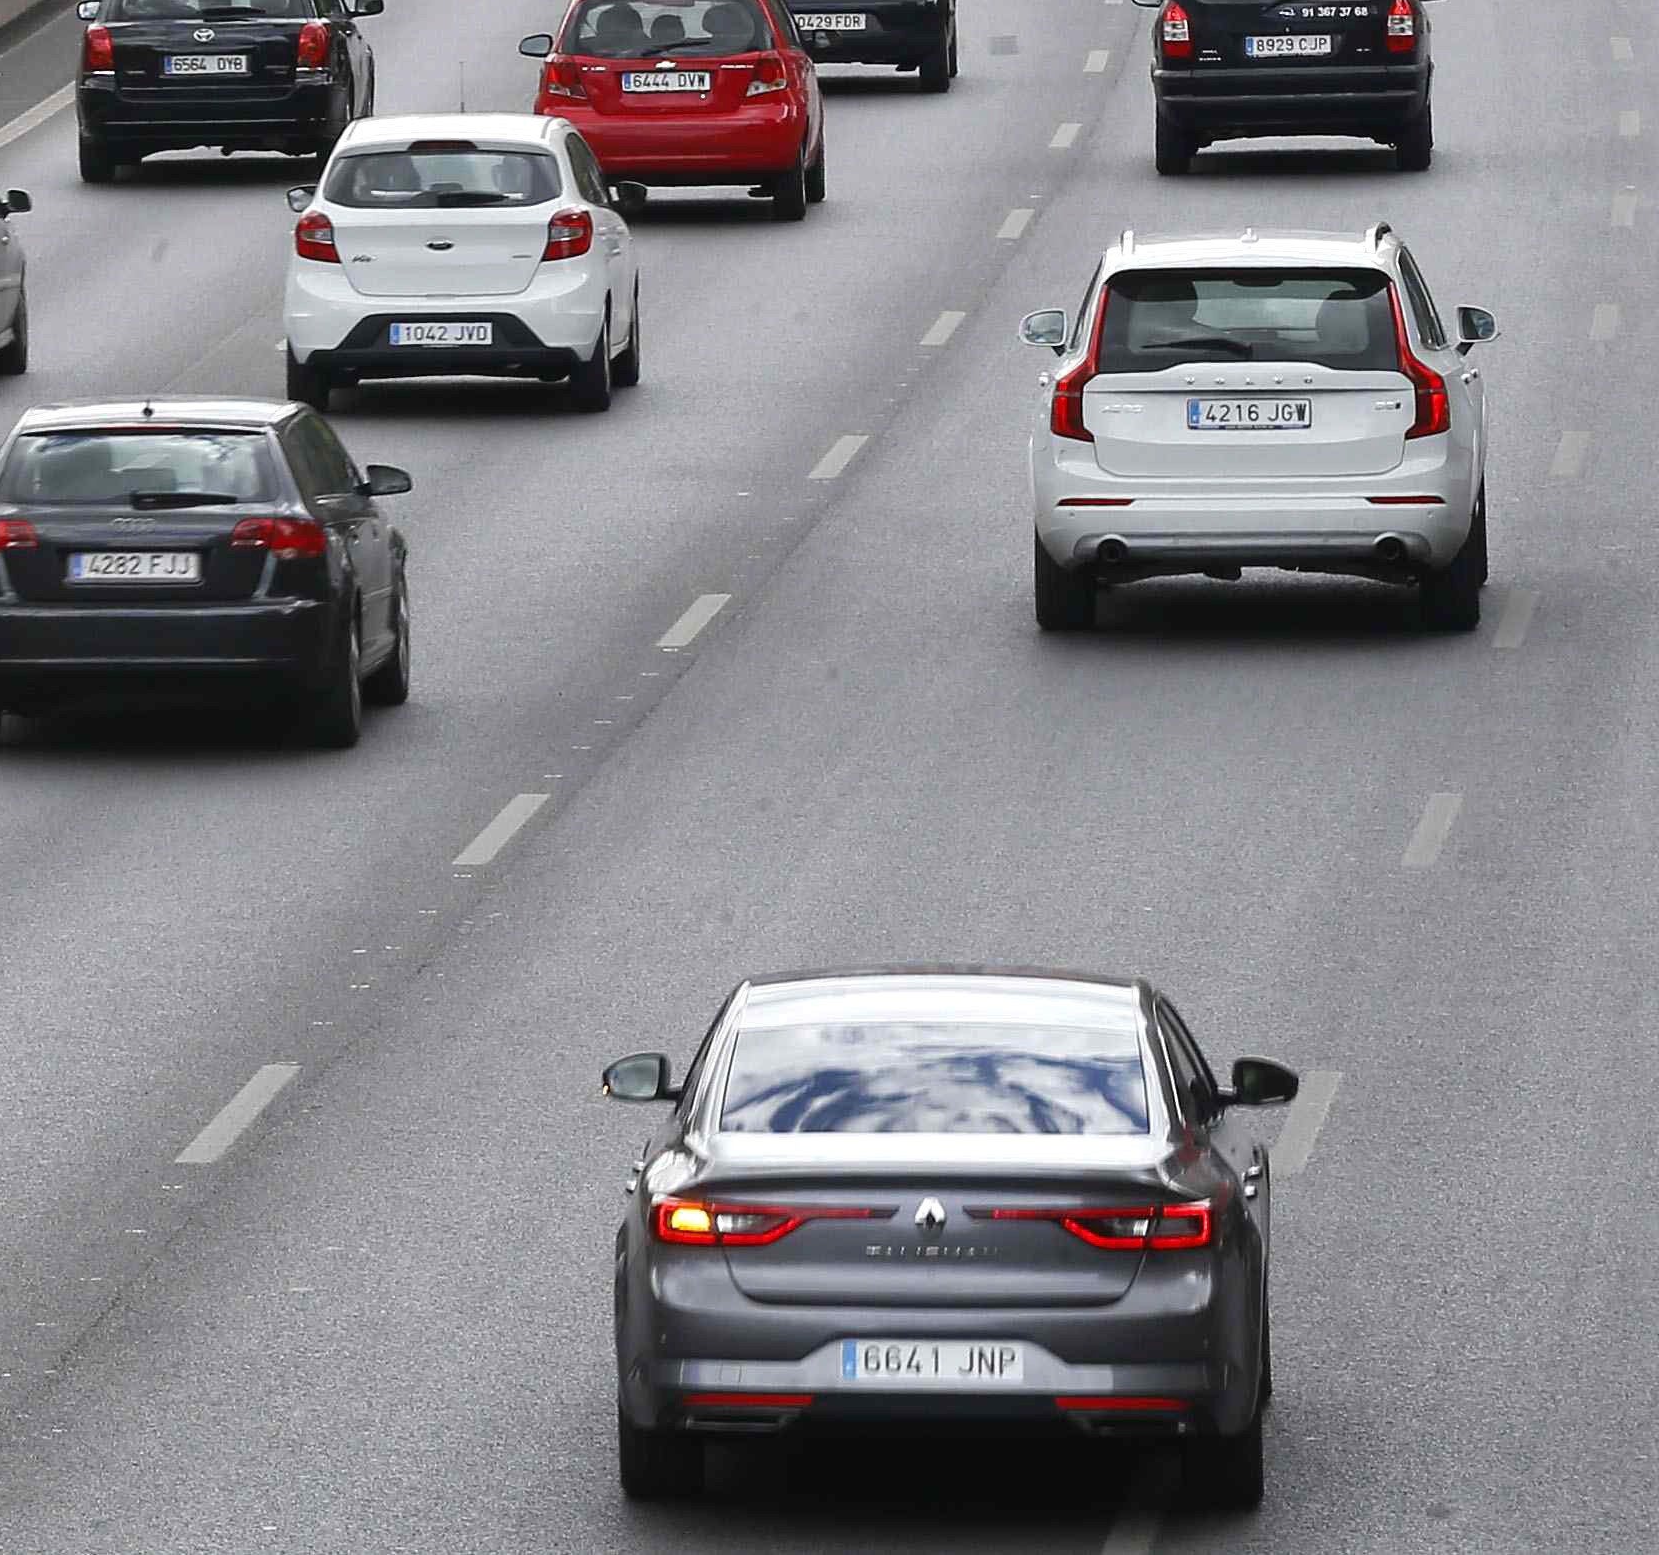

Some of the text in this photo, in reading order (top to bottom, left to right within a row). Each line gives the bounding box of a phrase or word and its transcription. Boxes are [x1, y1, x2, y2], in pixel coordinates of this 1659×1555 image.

[1301, 6, 1368, 18] 91 367 37 68
[836, 15, 860, 27] FDR
[1256, 37, 1327, 52] 8929 CJP
[174, 57, 242, 71] 6564 DYB
[633, 73, 705, 88] 6444 DVW
[405, 326, 488, 342] 1042 JVD
[1206, 404, 1307, 422] 4216 JGW
[89, 555, 191, 575] 4282 FJJ
[863, 1347, 1016, 1374] 6641 JNP
